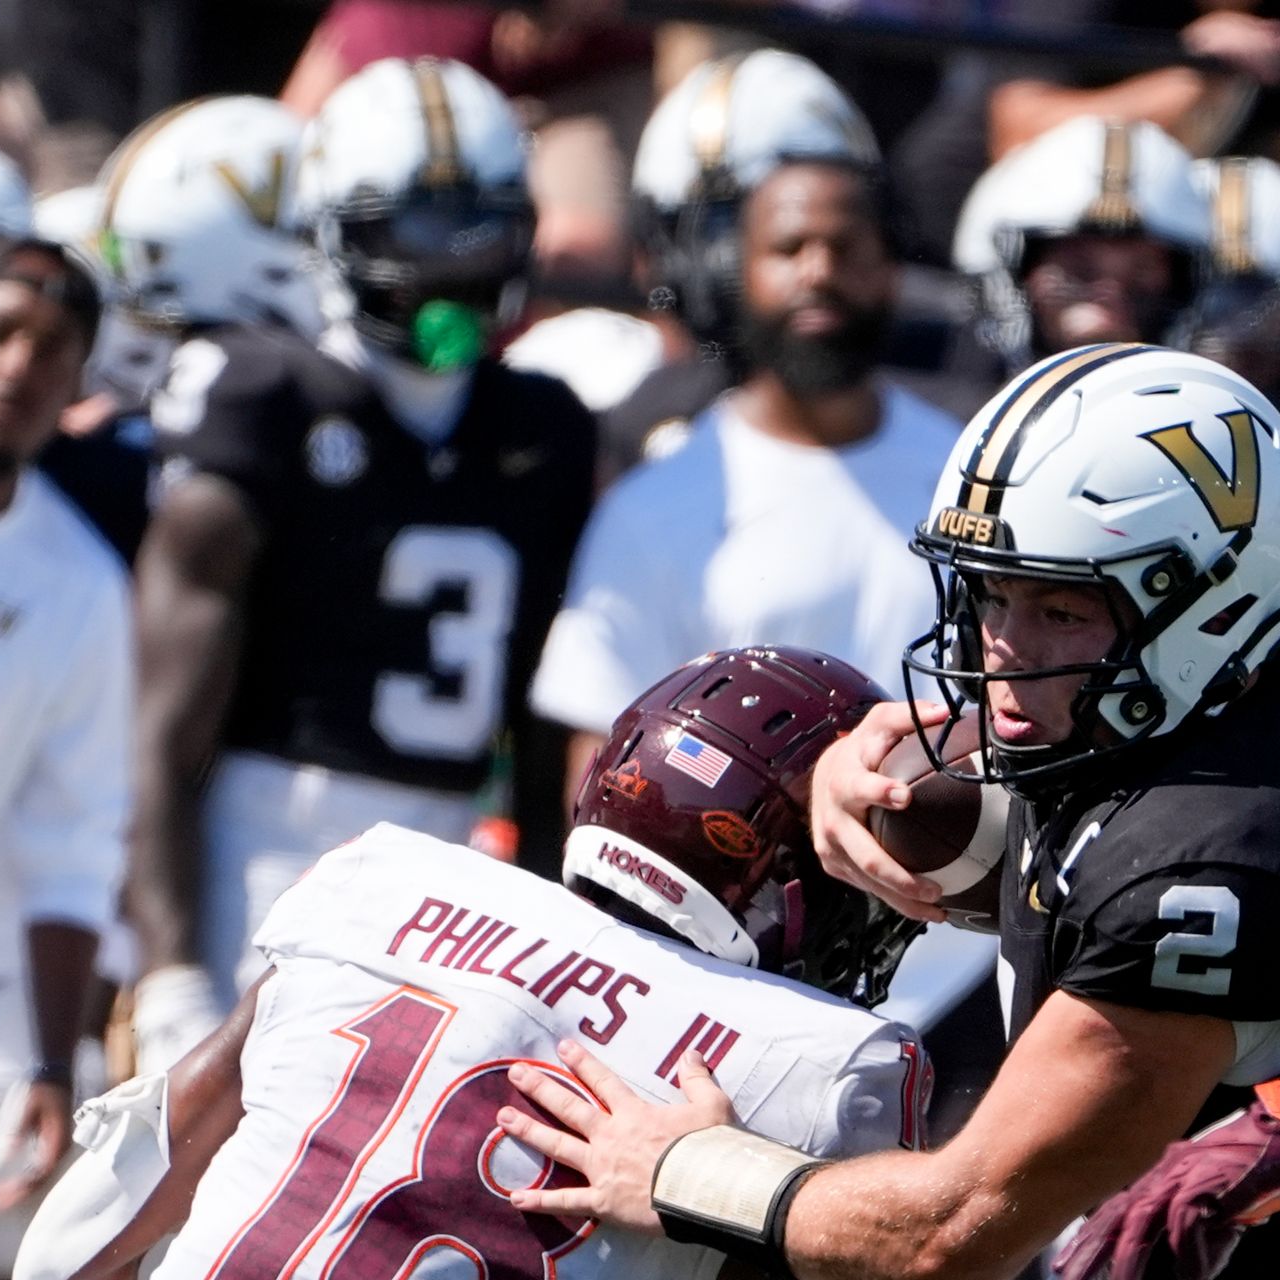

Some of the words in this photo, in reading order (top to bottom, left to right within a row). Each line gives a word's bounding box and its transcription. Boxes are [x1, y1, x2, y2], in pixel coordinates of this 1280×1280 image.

[211, 148, 286, 230] V
[1140, 405, 1262, 534] V
[938, 509, 995, 544] VUFB
[370, 523, 522, 761] 3
[597, 841, 688, 906] HOKIES
[386, 896, 652, 1047] PHILLIPS
[654, 1011, 742, 1089] III
[1151, 884, 1241, 996] 2
